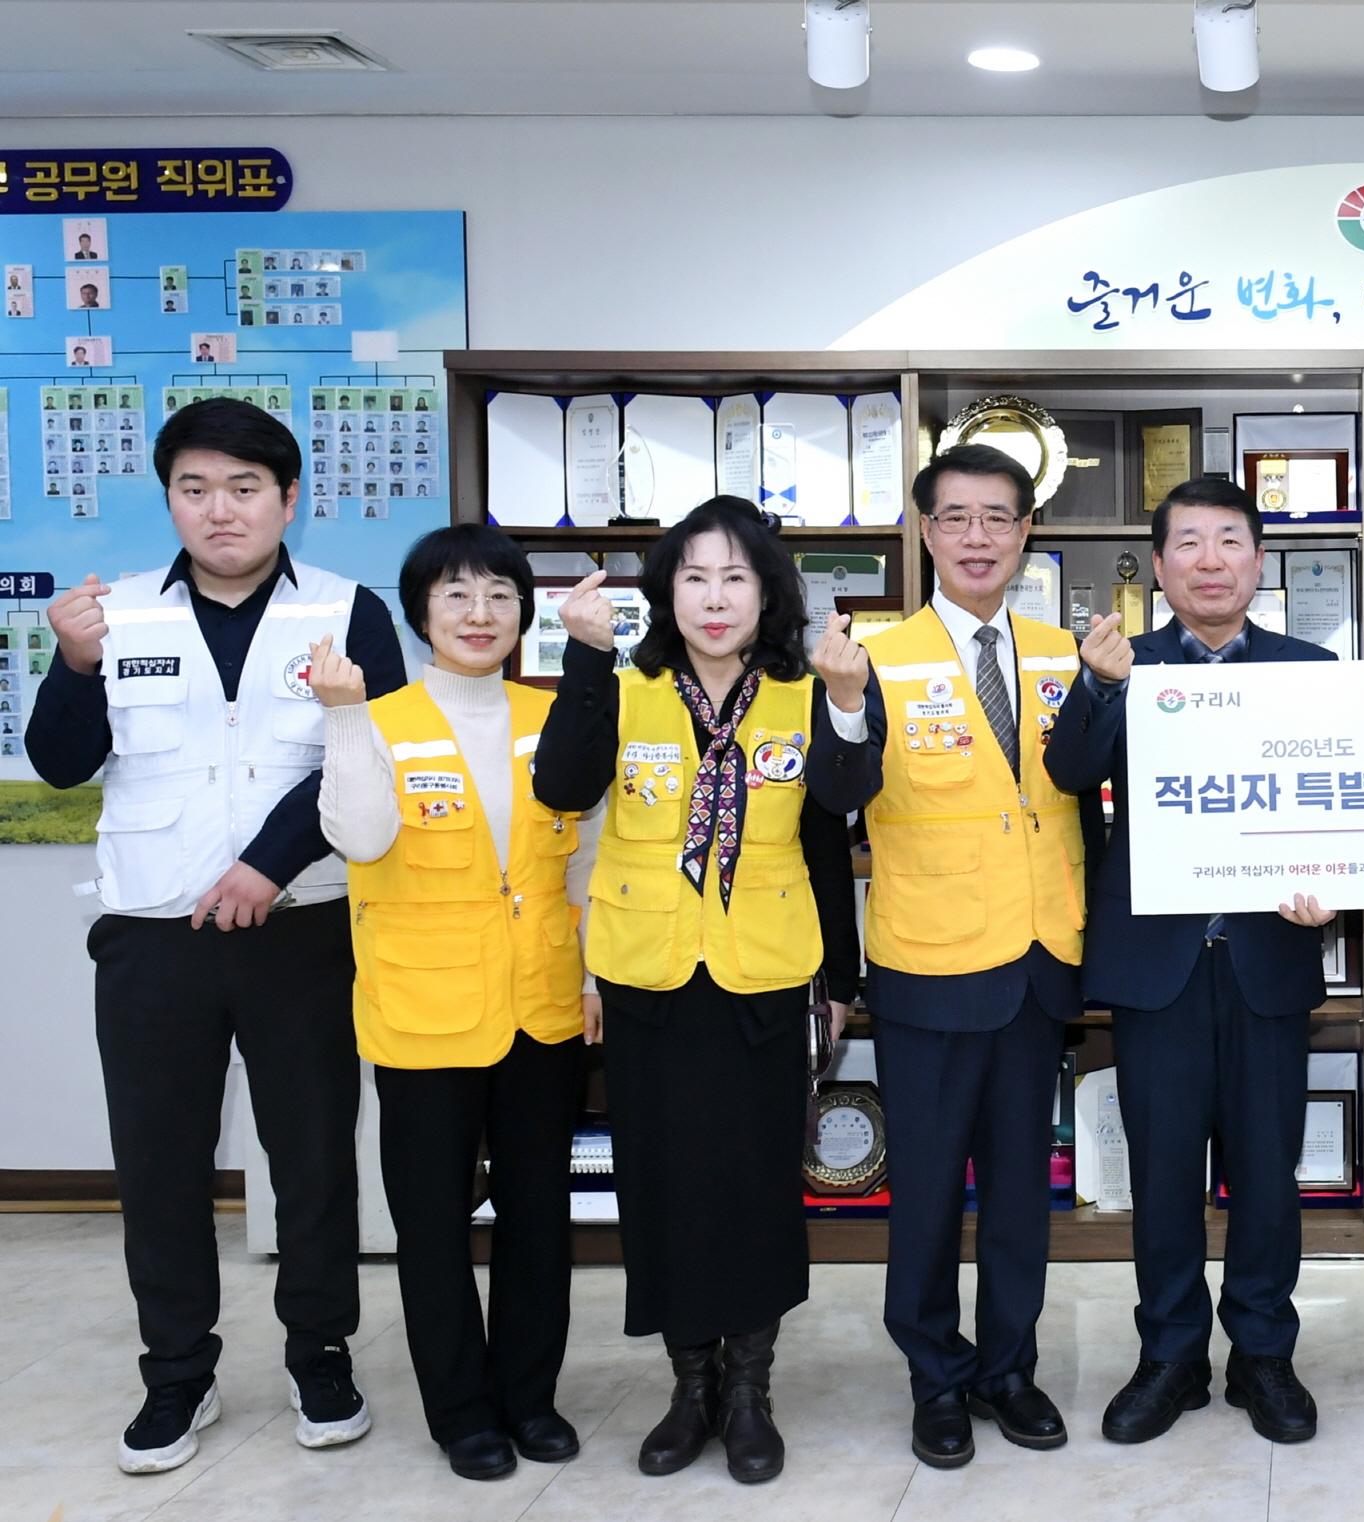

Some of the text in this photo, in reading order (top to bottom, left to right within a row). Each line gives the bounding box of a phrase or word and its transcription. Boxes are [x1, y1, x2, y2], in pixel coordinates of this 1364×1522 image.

[23, 160, 139, 200] 공무원
[157, 158, 277, 198] 직위표
[1067, 272, 1211, 330] 즐거운
[1236, 270, 1341, 325] 변화,
[122, 659, 175, 668] 대한적십자사
[122, 668, 174, 677] 경기도지사
[1190, 691, 1241, 708] 구리시
[1261, 737, 1356, 759] 2026년도
[1155, 773, 1281, 814] 적십자
[1192, 865, 1236, 878] 구리시와
[1240, 863, 1284, 877] 적십자가
[1288, 863, 1322, 876] 어려운
